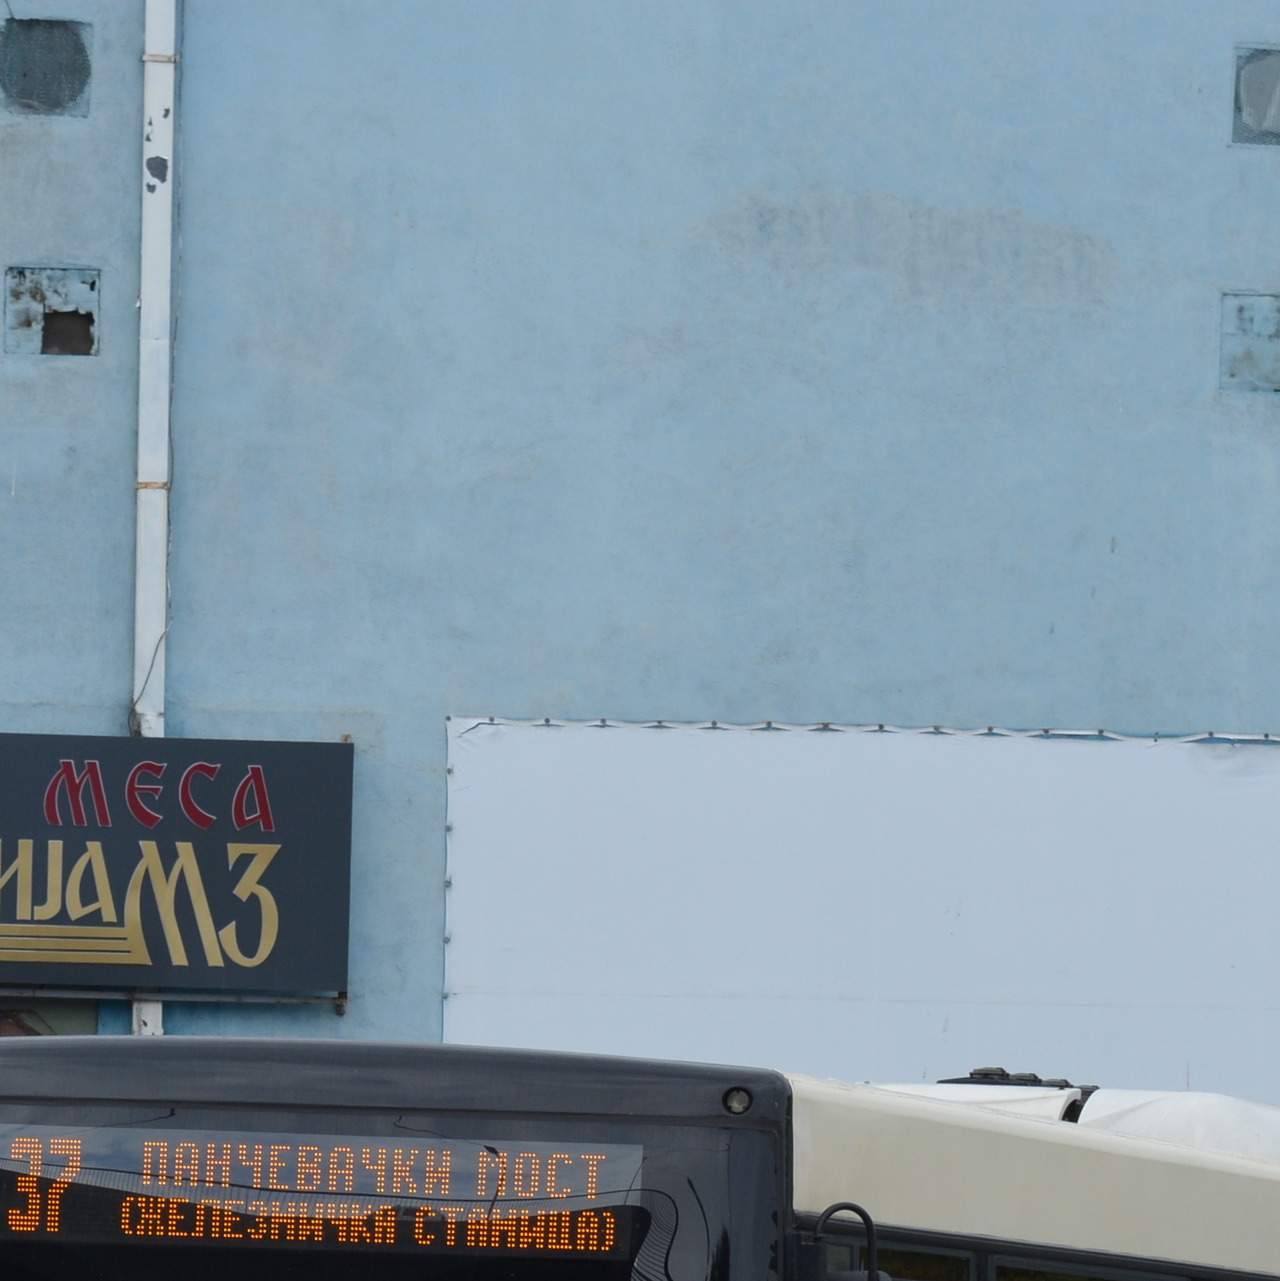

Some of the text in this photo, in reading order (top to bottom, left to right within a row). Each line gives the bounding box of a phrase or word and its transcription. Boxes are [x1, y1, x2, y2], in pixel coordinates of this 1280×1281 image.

[43, 757, 277, 833] МЕСА
[7, 1137, 82, 1232] 37
[141, 1140, 607, 1199] ПАНЧЕВАЧКИ МОСТ
[120, 1195, 616, 1251] (ЖЕЛЕЗНИЧКА СТАНИЦА)
